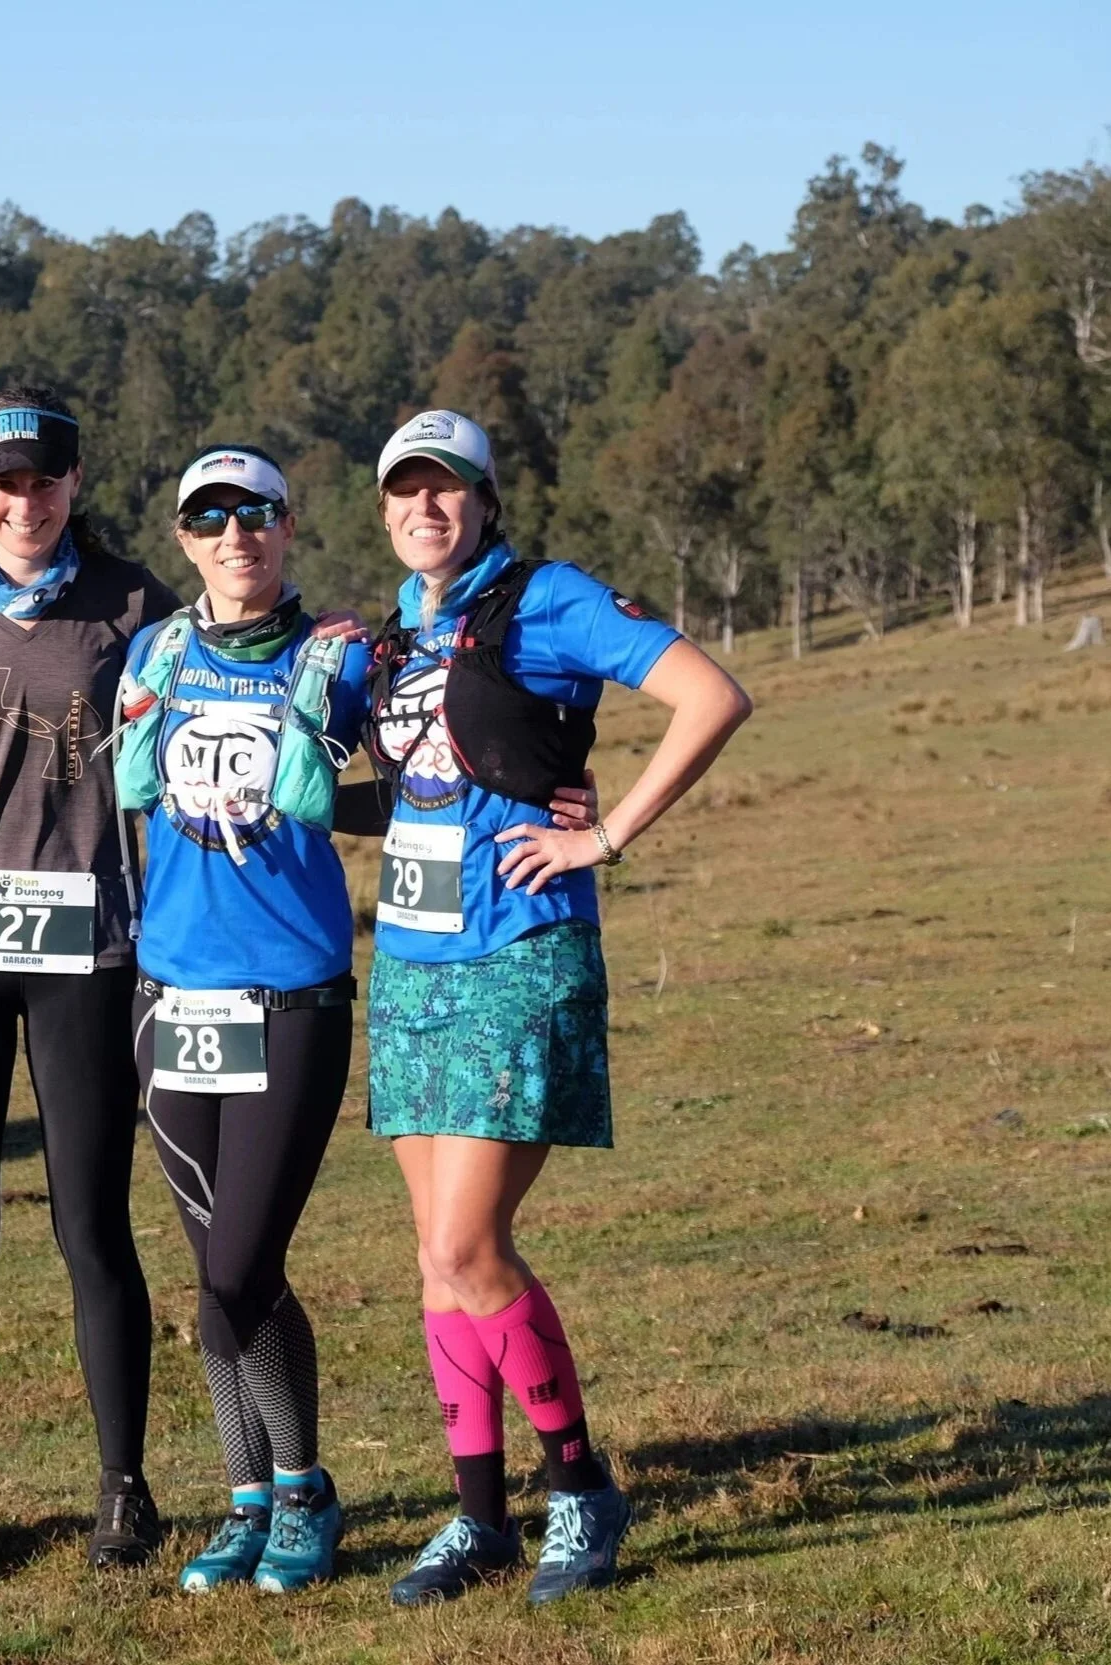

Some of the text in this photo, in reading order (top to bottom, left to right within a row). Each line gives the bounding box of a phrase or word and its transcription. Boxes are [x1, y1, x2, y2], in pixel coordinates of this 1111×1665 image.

[21, 431, 39, 440] GIRL
[230, 677, 253, 696] TRI
[258, 680, 288, 697] CLU
[68, 690, 79, 785] UNDER ARMOUR
[15, 877, 39, 887] Run
[392, 858, 423, 907] 29
[15, 887, 64, 899] Dungog
[2, 956, 44, 965] DARACON
[183, 1006, 231, 1018] Dungog
[174, 1025, 223, 1072] 28
